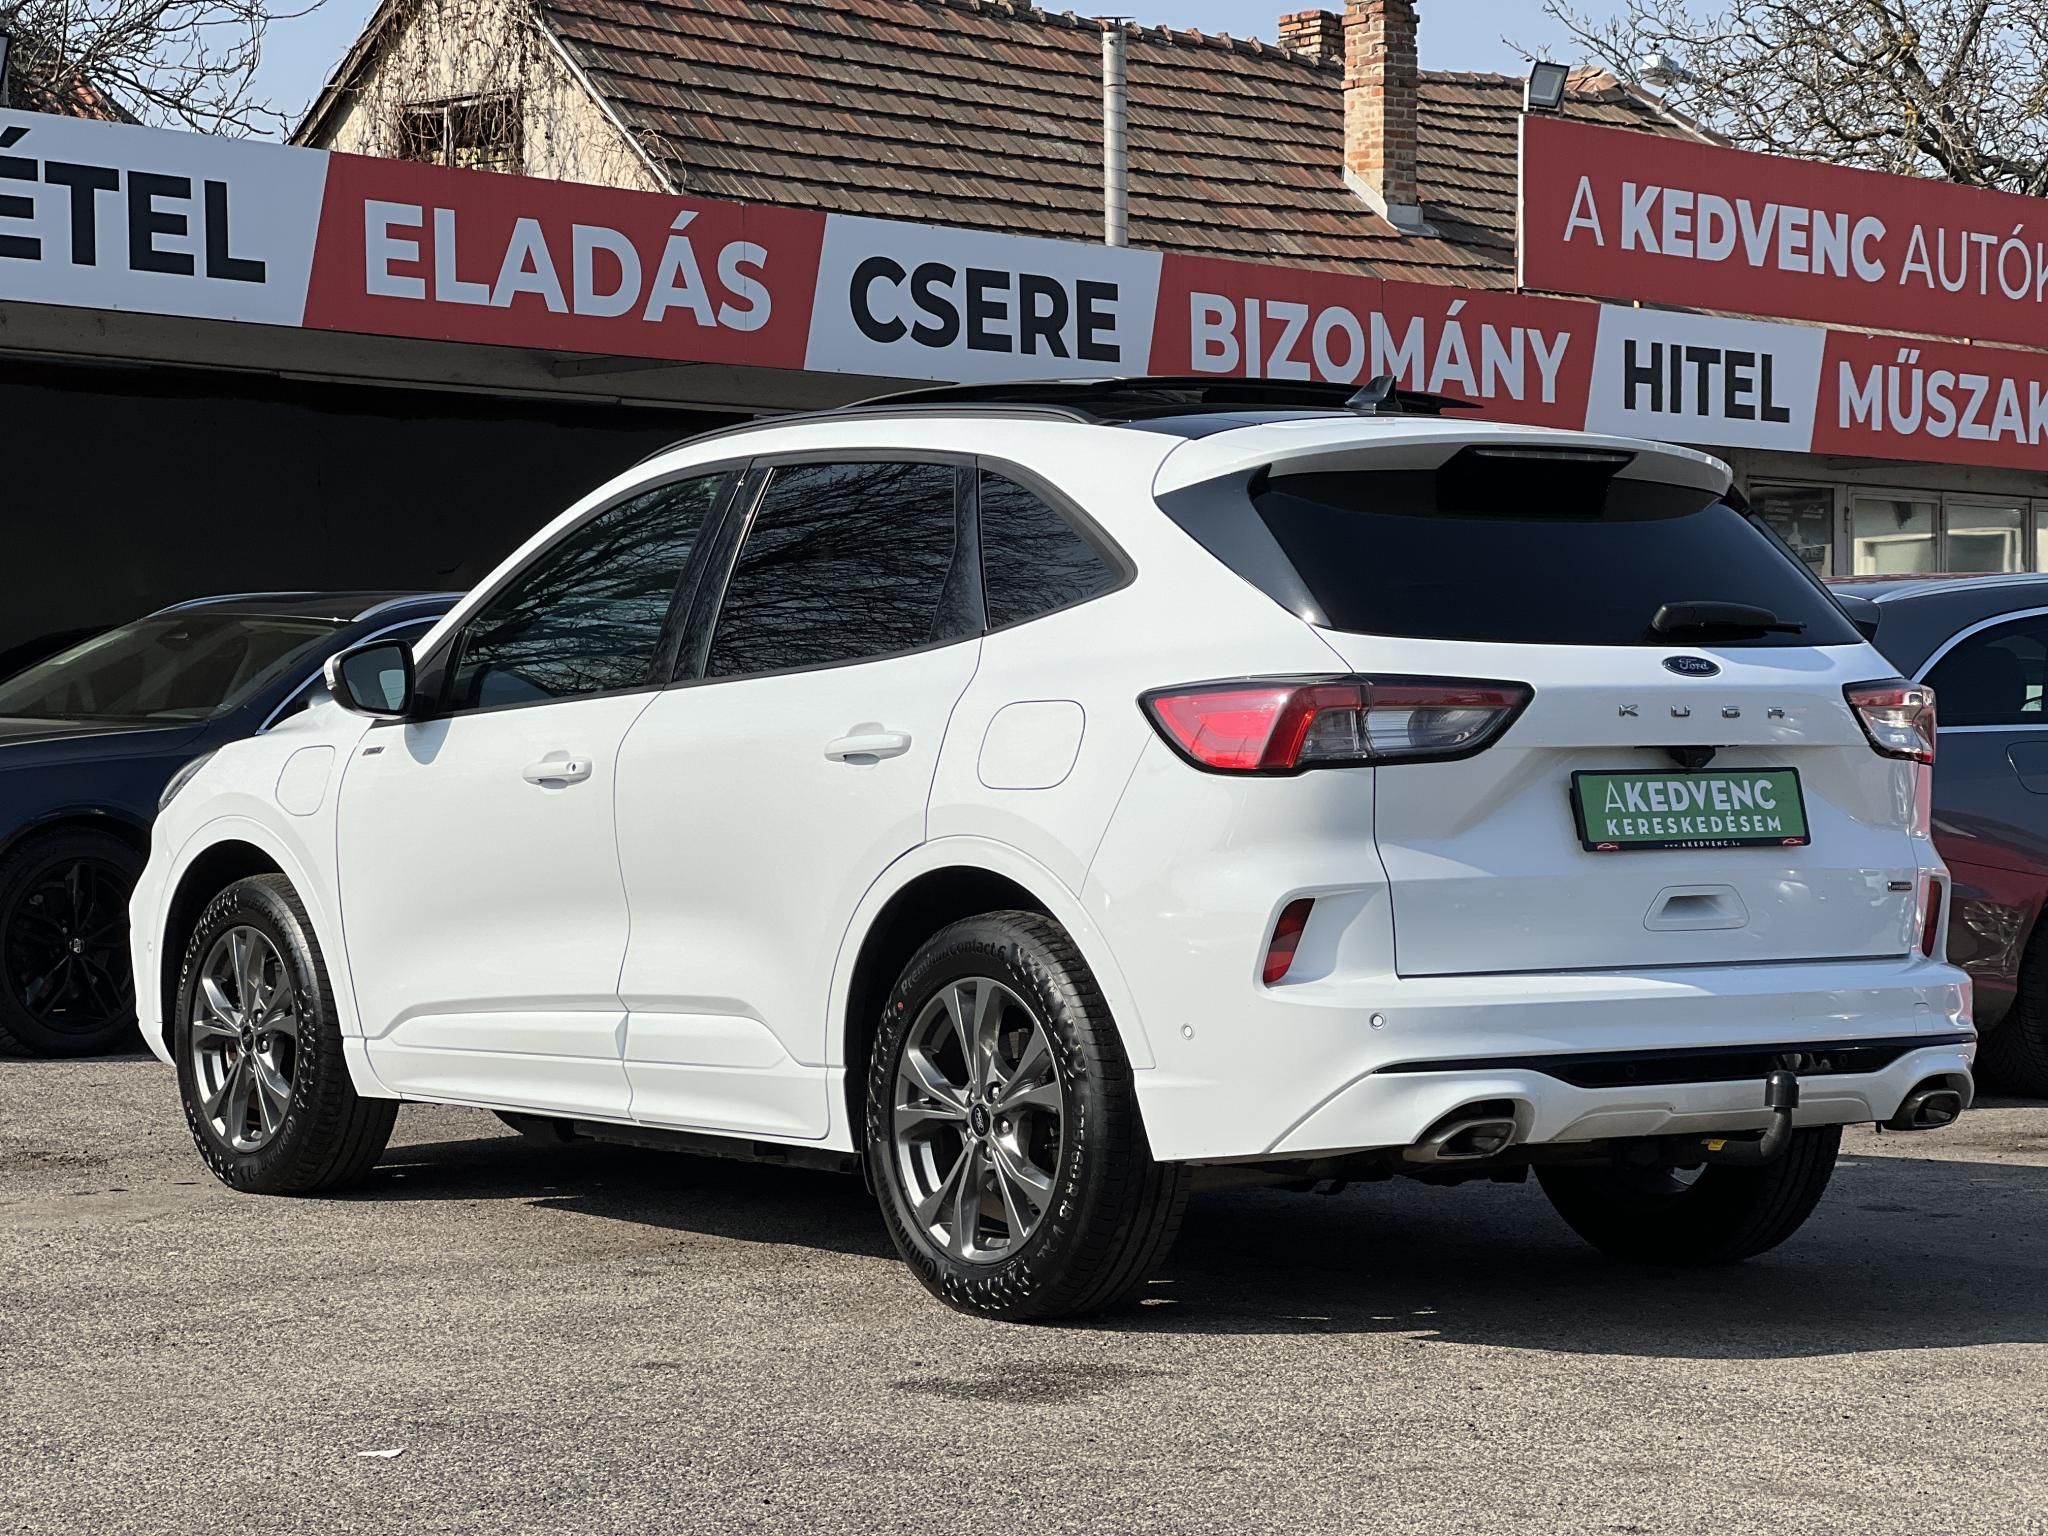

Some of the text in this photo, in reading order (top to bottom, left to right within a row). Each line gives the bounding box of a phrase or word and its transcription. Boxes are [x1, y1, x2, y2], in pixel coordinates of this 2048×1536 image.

[1563, 176, 1604, 247] A
[1621, 181, 1886, 283] KEDVENC
[0, 126, 265, 283] ÉTEL
[365, 199, 771, 332] ELADÁS
[849, 256, 1122, 363] CSERE
[1190, 292, 1571, 404] BIZOMÁNY
[1624, 339, 1790, 423] HITEL
[1679, 657, 1709, 670] Ford
[1618, 704, 1785, 719] KUGA
[1607, 811, 1782, 836] KERESKEDÉSEM
